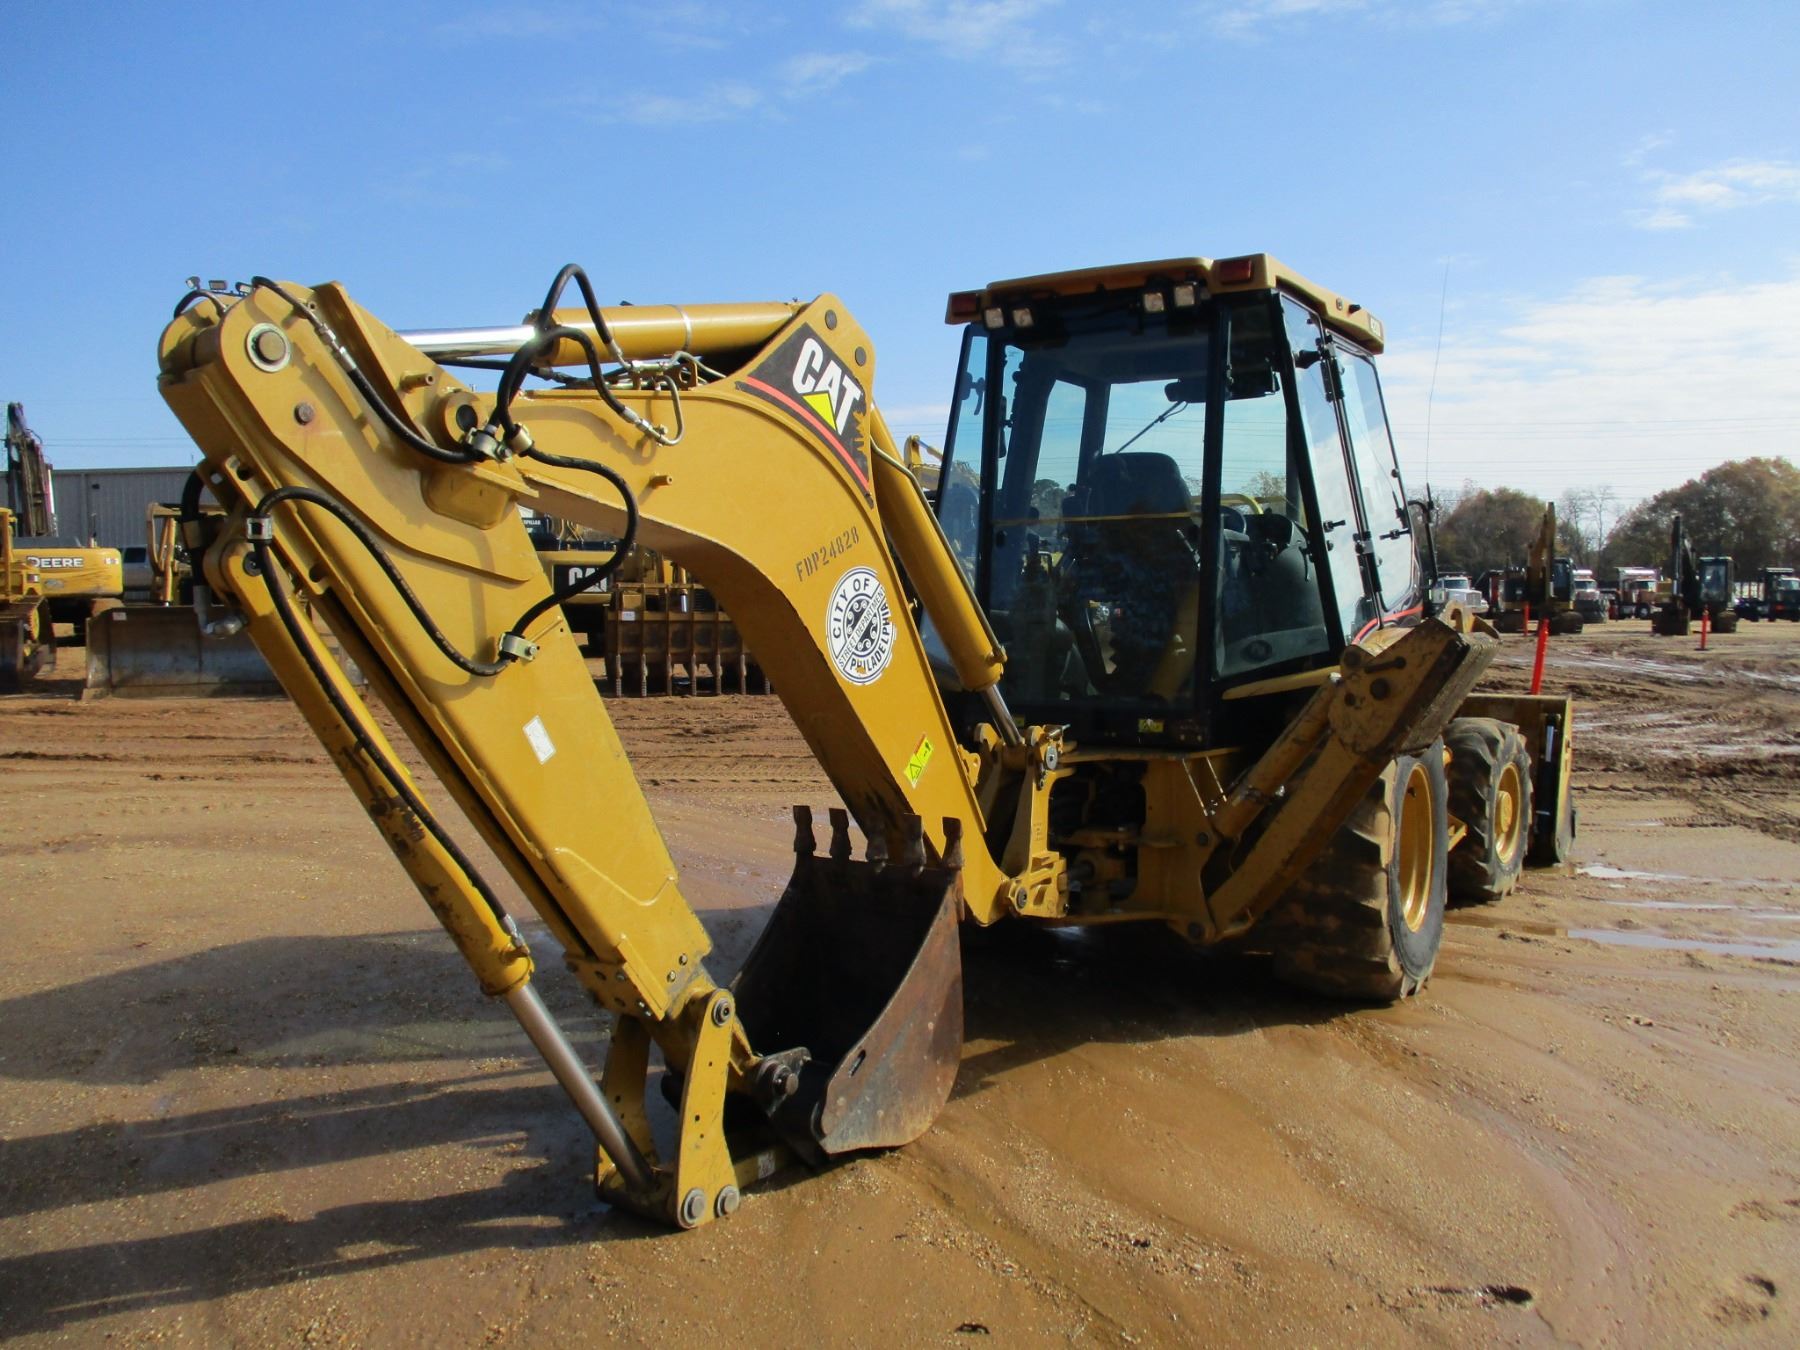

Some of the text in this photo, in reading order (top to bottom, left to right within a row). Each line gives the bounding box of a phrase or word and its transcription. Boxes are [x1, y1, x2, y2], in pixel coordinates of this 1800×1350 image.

[792, 338, 864, 436] CAT
[27, 556, 84, 568] DEERE
[832, 578, 870, 639] CITY OF
[849, 603, 891, 672] PHILADELPHIA
[838, 636, 857, 667] STREET
